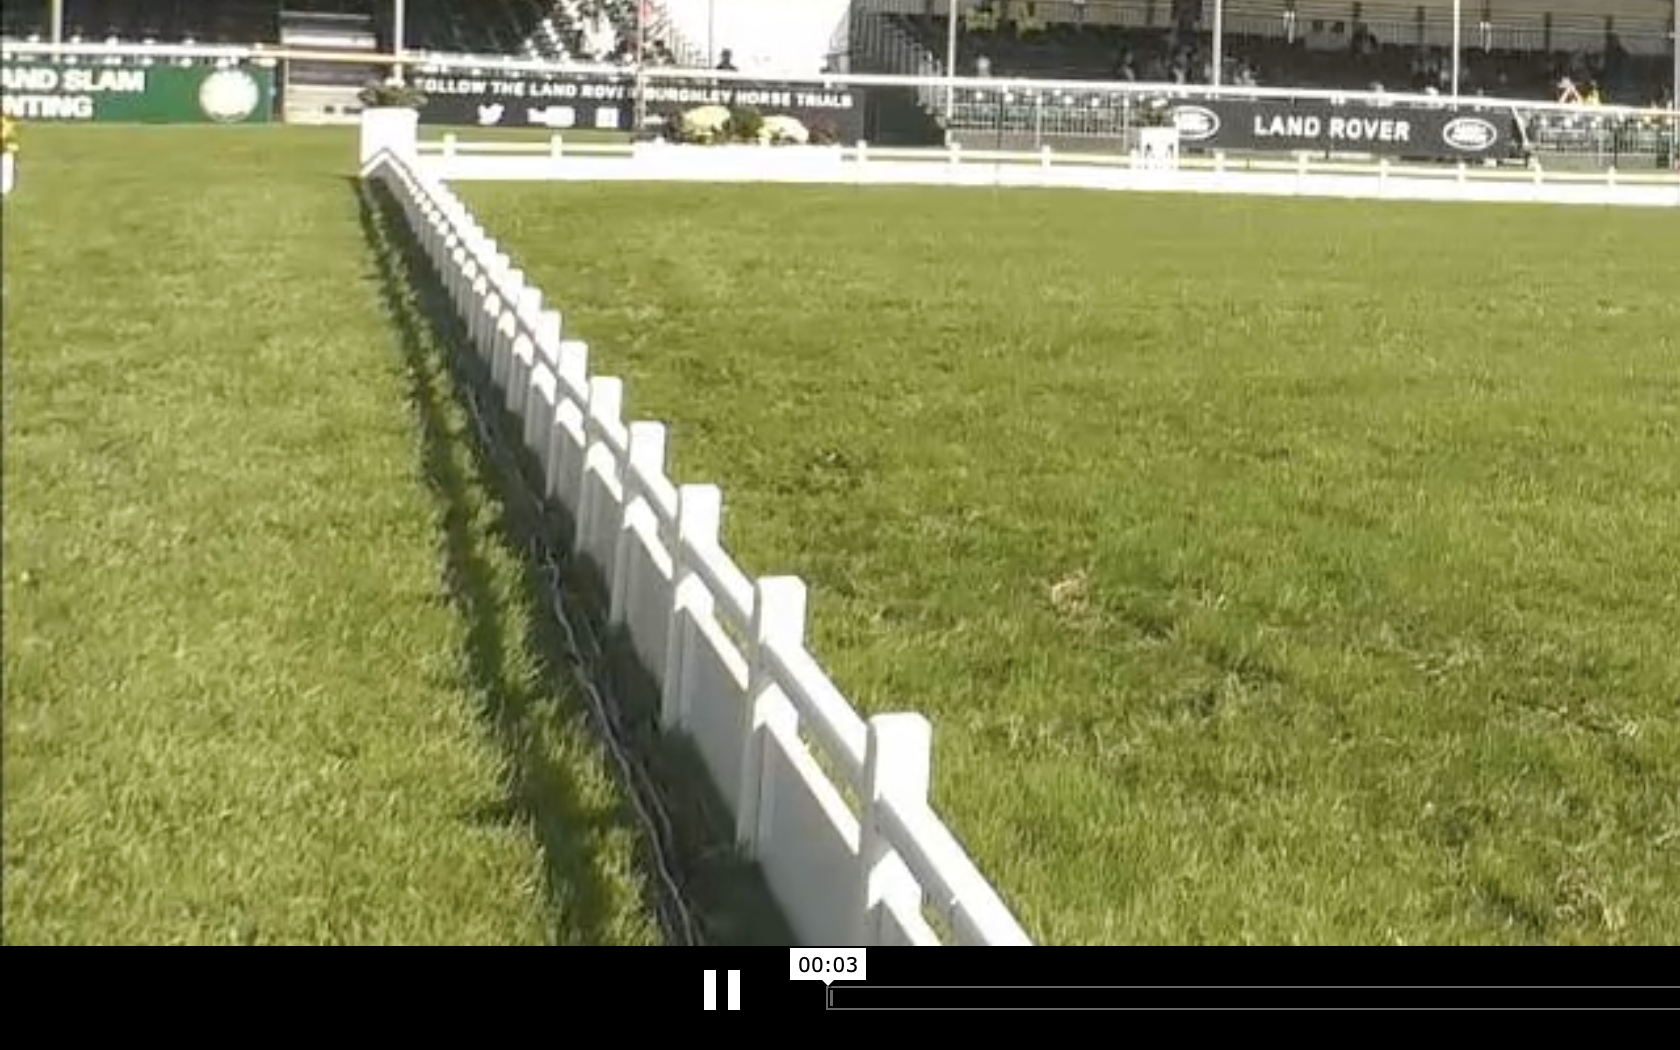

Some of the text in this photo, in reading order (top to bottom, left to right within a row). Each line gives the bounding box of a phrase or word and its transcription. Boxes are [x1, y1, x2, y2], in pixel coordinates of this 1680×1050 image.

[62, 69, 146, 91] SLAM
[491, 81, 525, 96] THE
[530, 83, 578, 97] LAND
[735, 90, 791, 106] HORSE
[796, 92, 853, 108] TRIALS
[1254, 115, 1411, 142] LAND ROVER
